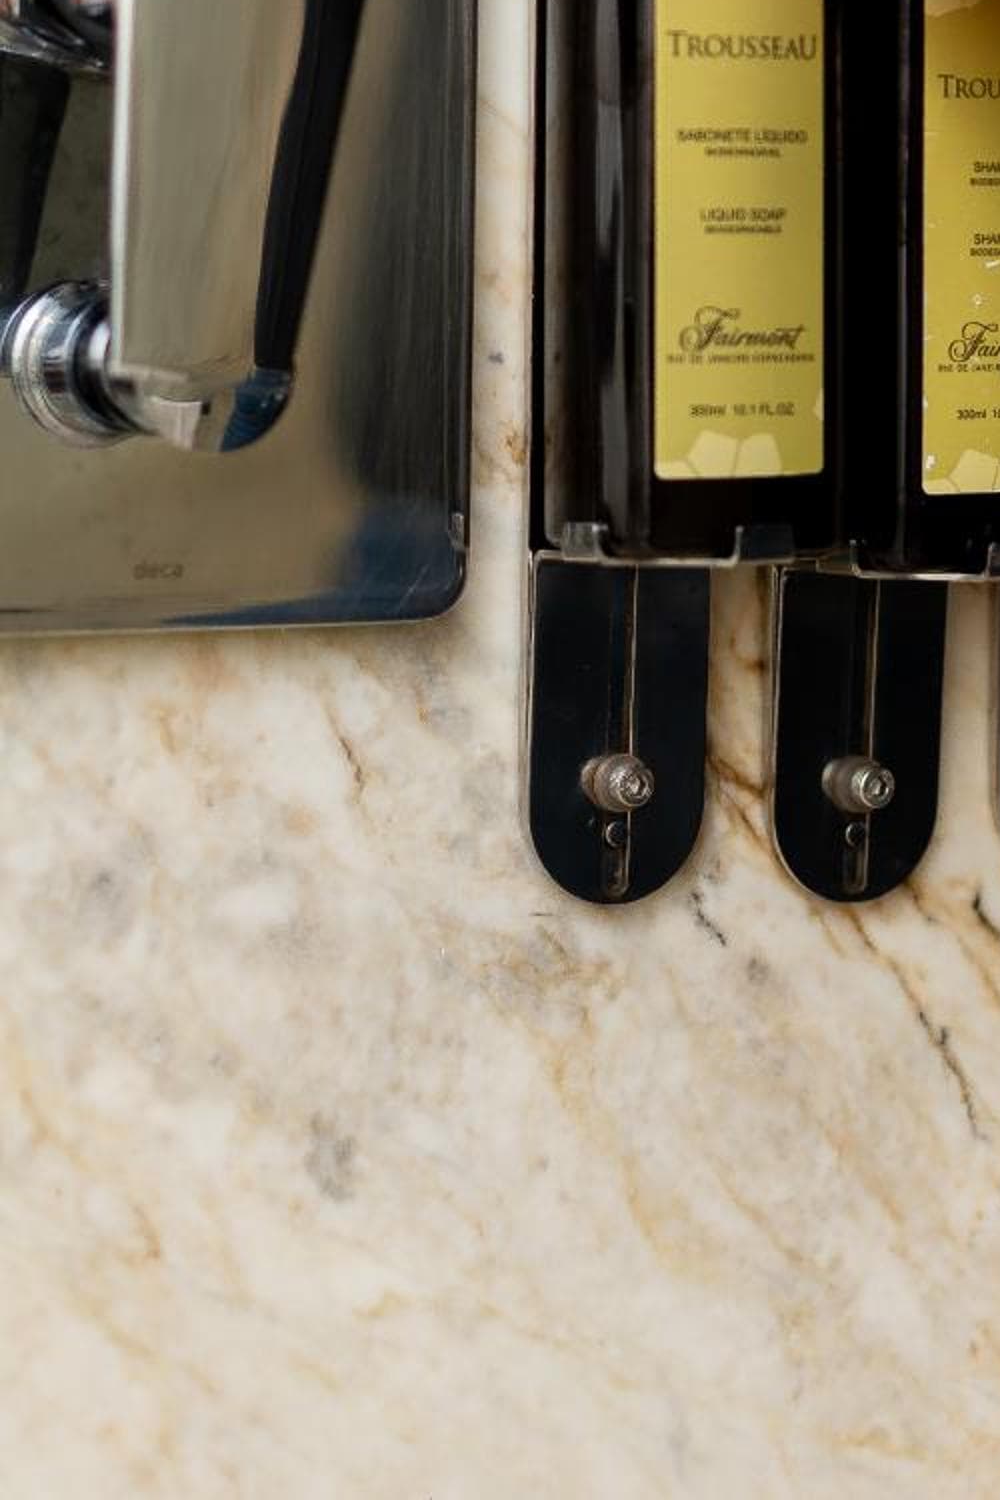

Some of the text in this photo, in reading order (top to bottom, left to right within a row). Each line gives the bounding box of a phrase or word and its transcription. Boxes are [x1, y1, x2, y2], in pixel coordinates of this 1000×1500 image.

[667, 29, 817, 61] TROUSSEAU
[679, 305, 805, 352] Fairmont
[133, 560, 184, 580] deca
